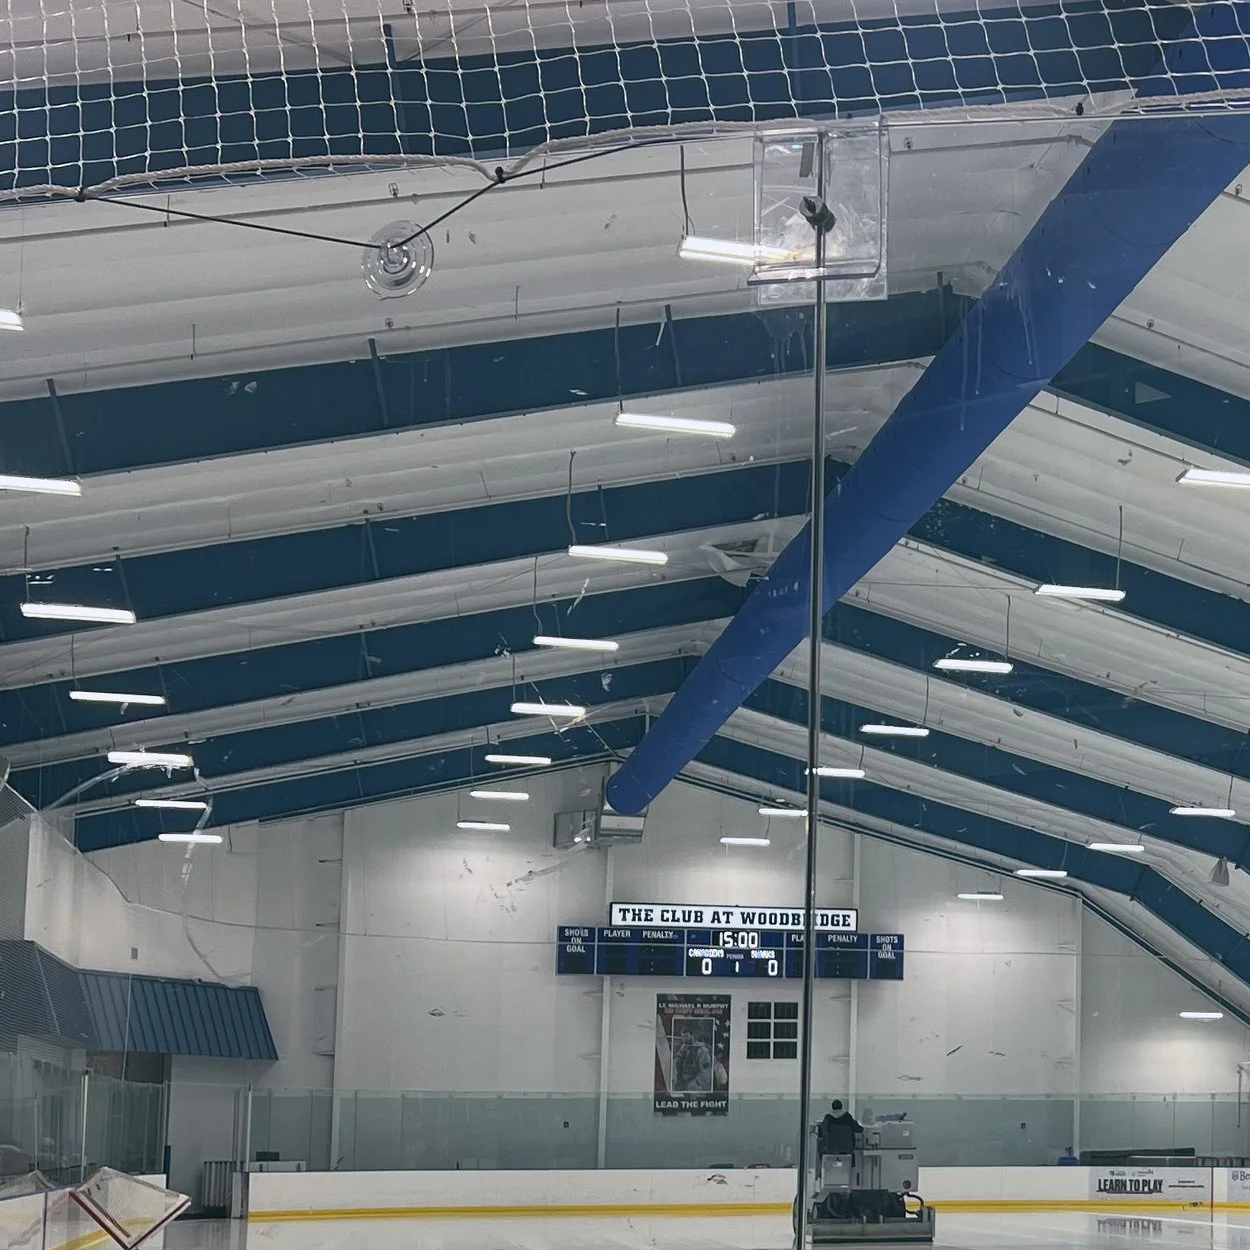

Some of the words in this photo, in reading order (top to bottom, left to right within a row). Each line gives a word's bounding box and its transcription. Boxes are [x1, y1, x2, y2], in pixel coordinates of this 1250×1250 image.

[619, 908, 653, 922] THE
[661, 909, 704, 924] CLUB
[711, 911, 734, 924] AT
[741, 911, 851, 927] WOODBIDGE
[564, 928, 589, 937] SHOTS
[603, 930, 631, 938] PLAYER
[642, 930, 674, 939] PENALTY
[571, 937, 582, 945] ON
[719, 931, 758, 948] 15:00
[828, 934, 858, 944] PENALTY
[876, 935, 898, 944] SHOTS
[566, 945, 586, 953] GOAL
[878, 952, 896, 960] GOAL
[702, 958, 712, 975] 0
[768, 959, 778, 976] 0
[700, 1100, 727, 1108] FIGHT
[1098, 1179, 1127, 1192] LEARN
[1128, 1179, 1140, 1192] TO
[1142, 1179, 1163, 1193] PLAY
